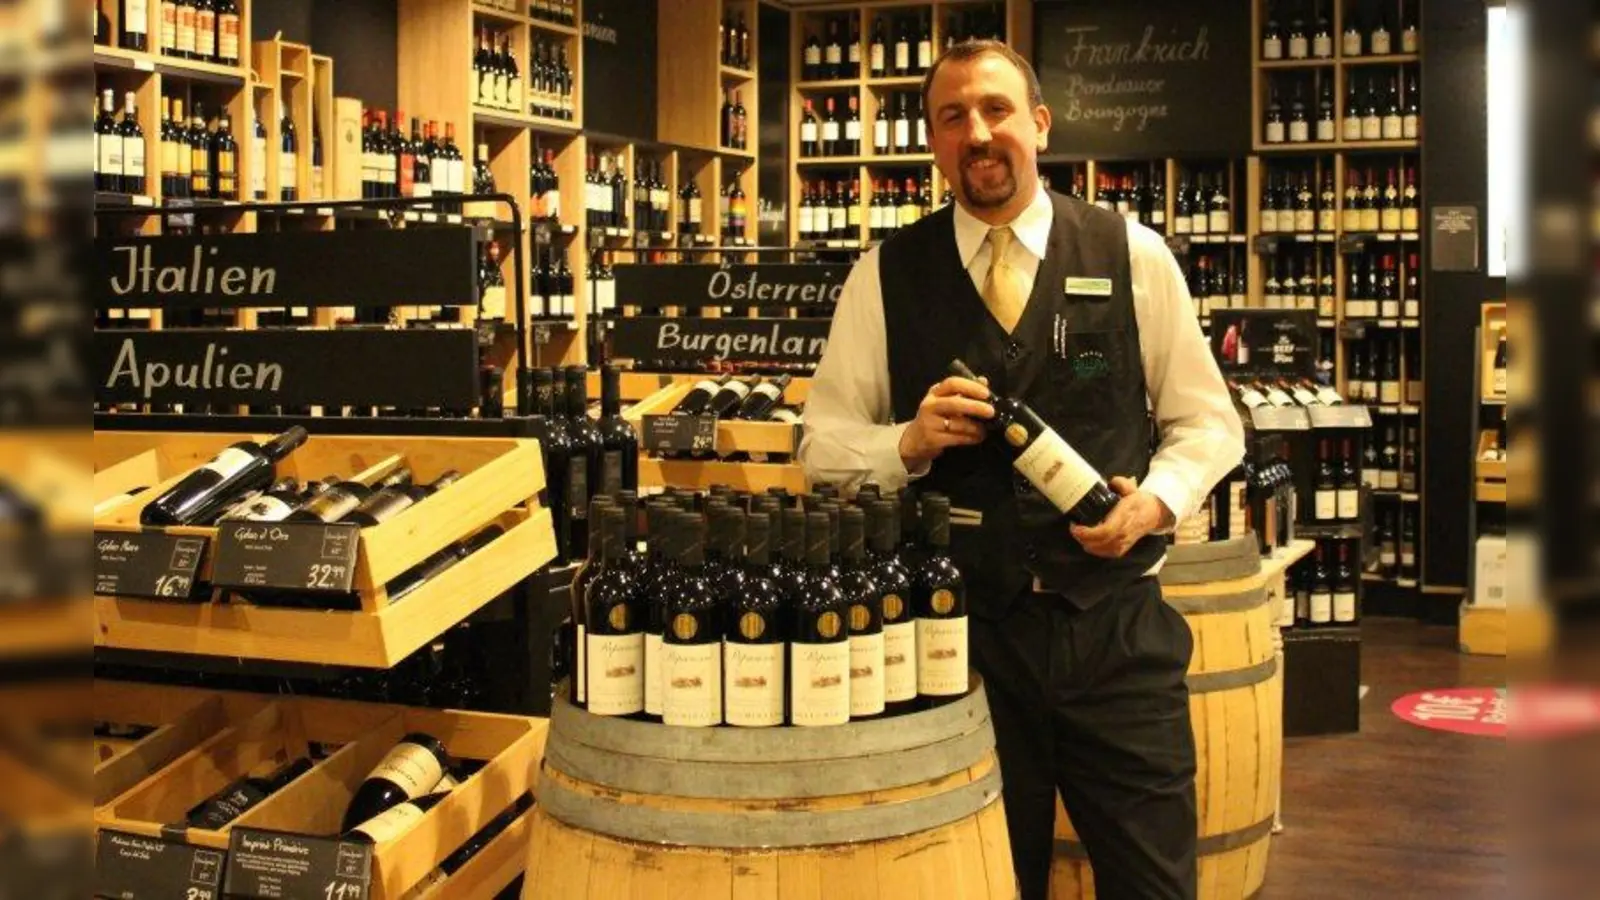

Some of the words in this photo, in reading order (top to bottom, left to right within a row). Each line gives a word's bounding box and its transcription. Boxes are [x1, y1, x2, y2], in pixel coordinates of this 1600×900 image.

[1066, 73, 1165, 97] Bordeaux
[1066, 100, 1168, 131] Bourgogne
[707, 262, 843, 302] Österreic
[657, 322, 828, 361] Burgenlan
[106, 338, 283, 398] Apulien
